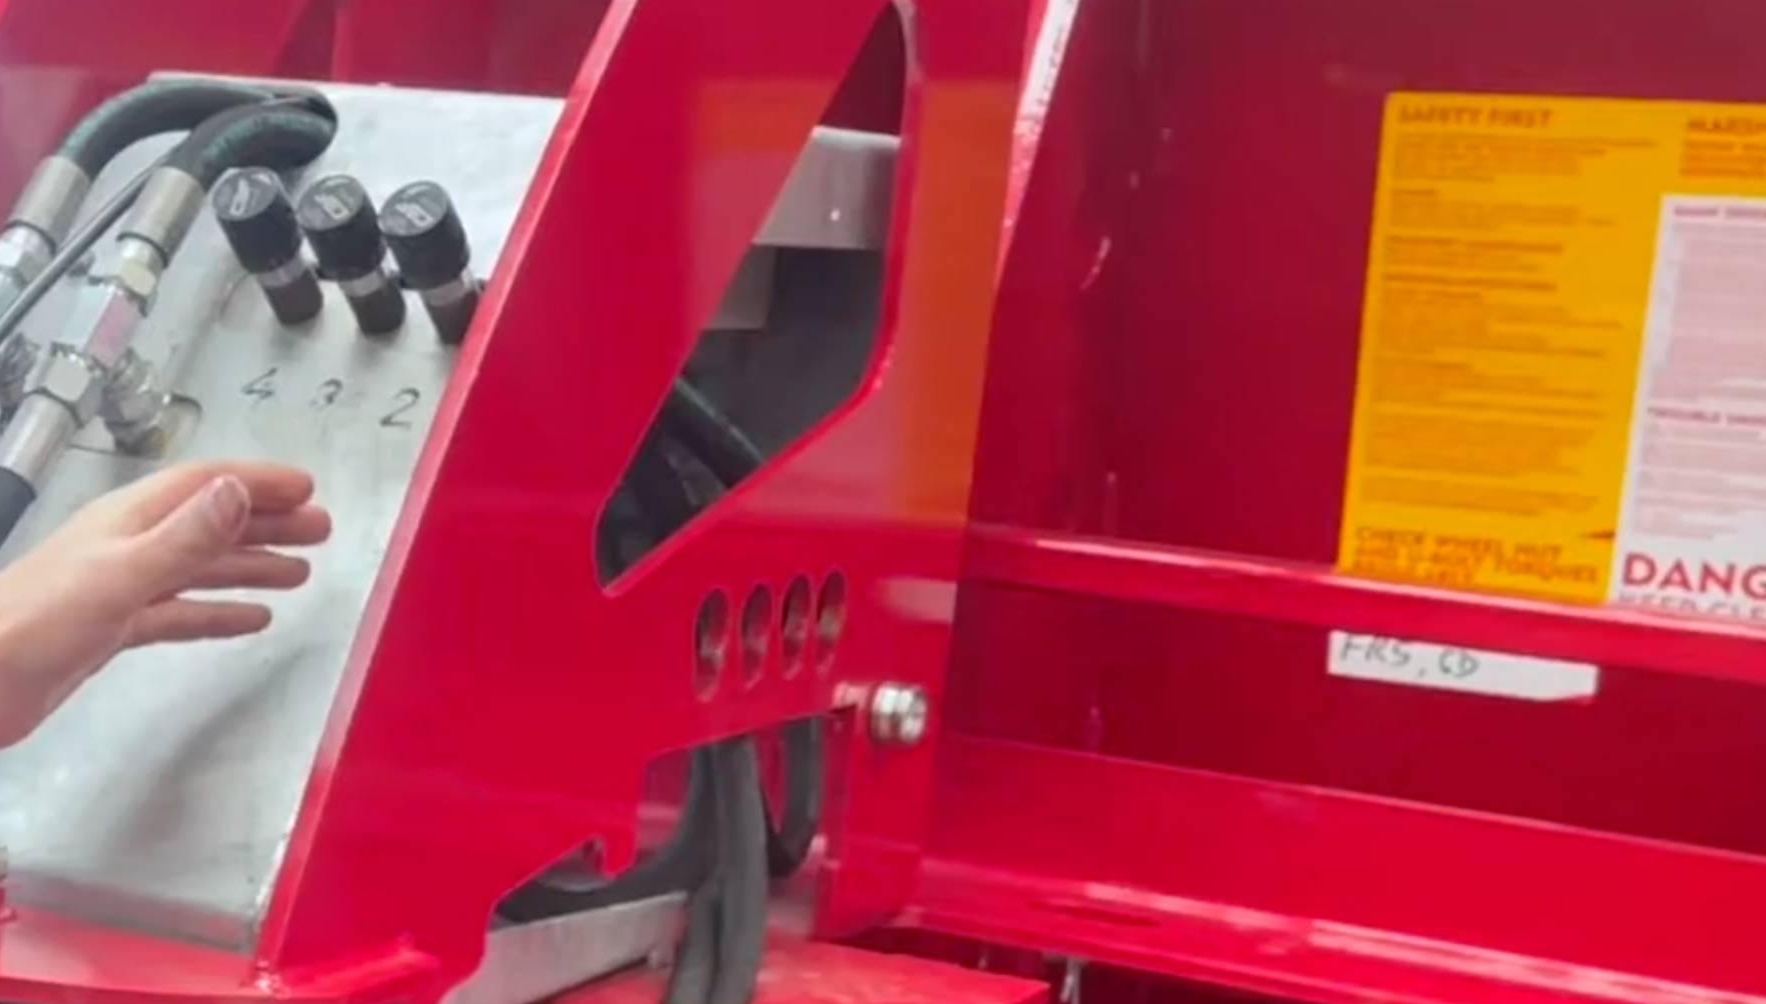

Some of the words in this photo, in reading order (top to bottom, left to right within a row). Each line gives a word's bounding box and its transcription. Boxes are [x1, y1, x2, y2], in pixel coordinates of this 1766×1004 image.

[240, 367, 278, 405] 4
[379, 387, 420, 429] 2
[1623, 553, 1766, 600] DANG
